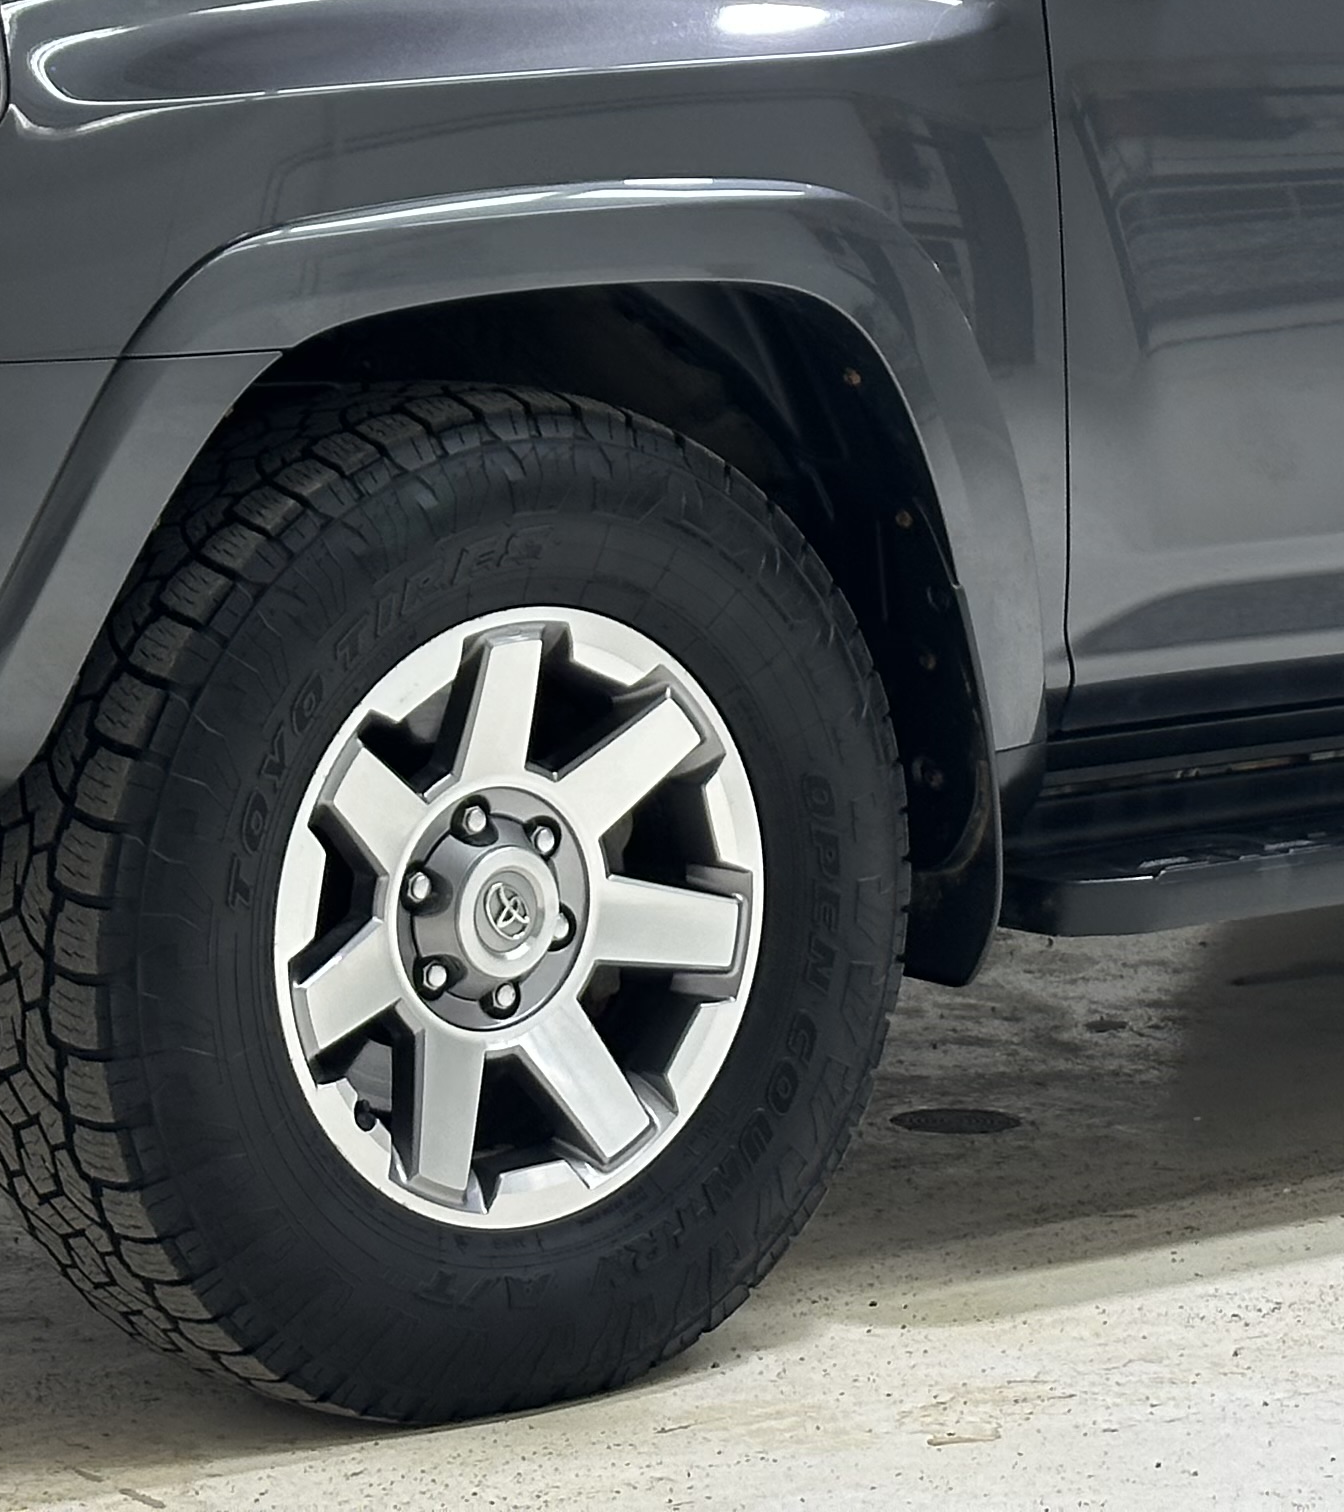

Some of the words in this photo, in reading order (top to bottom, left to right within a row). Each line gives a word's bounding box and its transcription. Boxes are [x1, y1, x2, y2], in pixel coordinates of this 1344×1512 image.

[225, 669, 324, 912] TOYO
[335, 524, 555, 673] TIRES
[800, 772, 842, 997] OPEN
